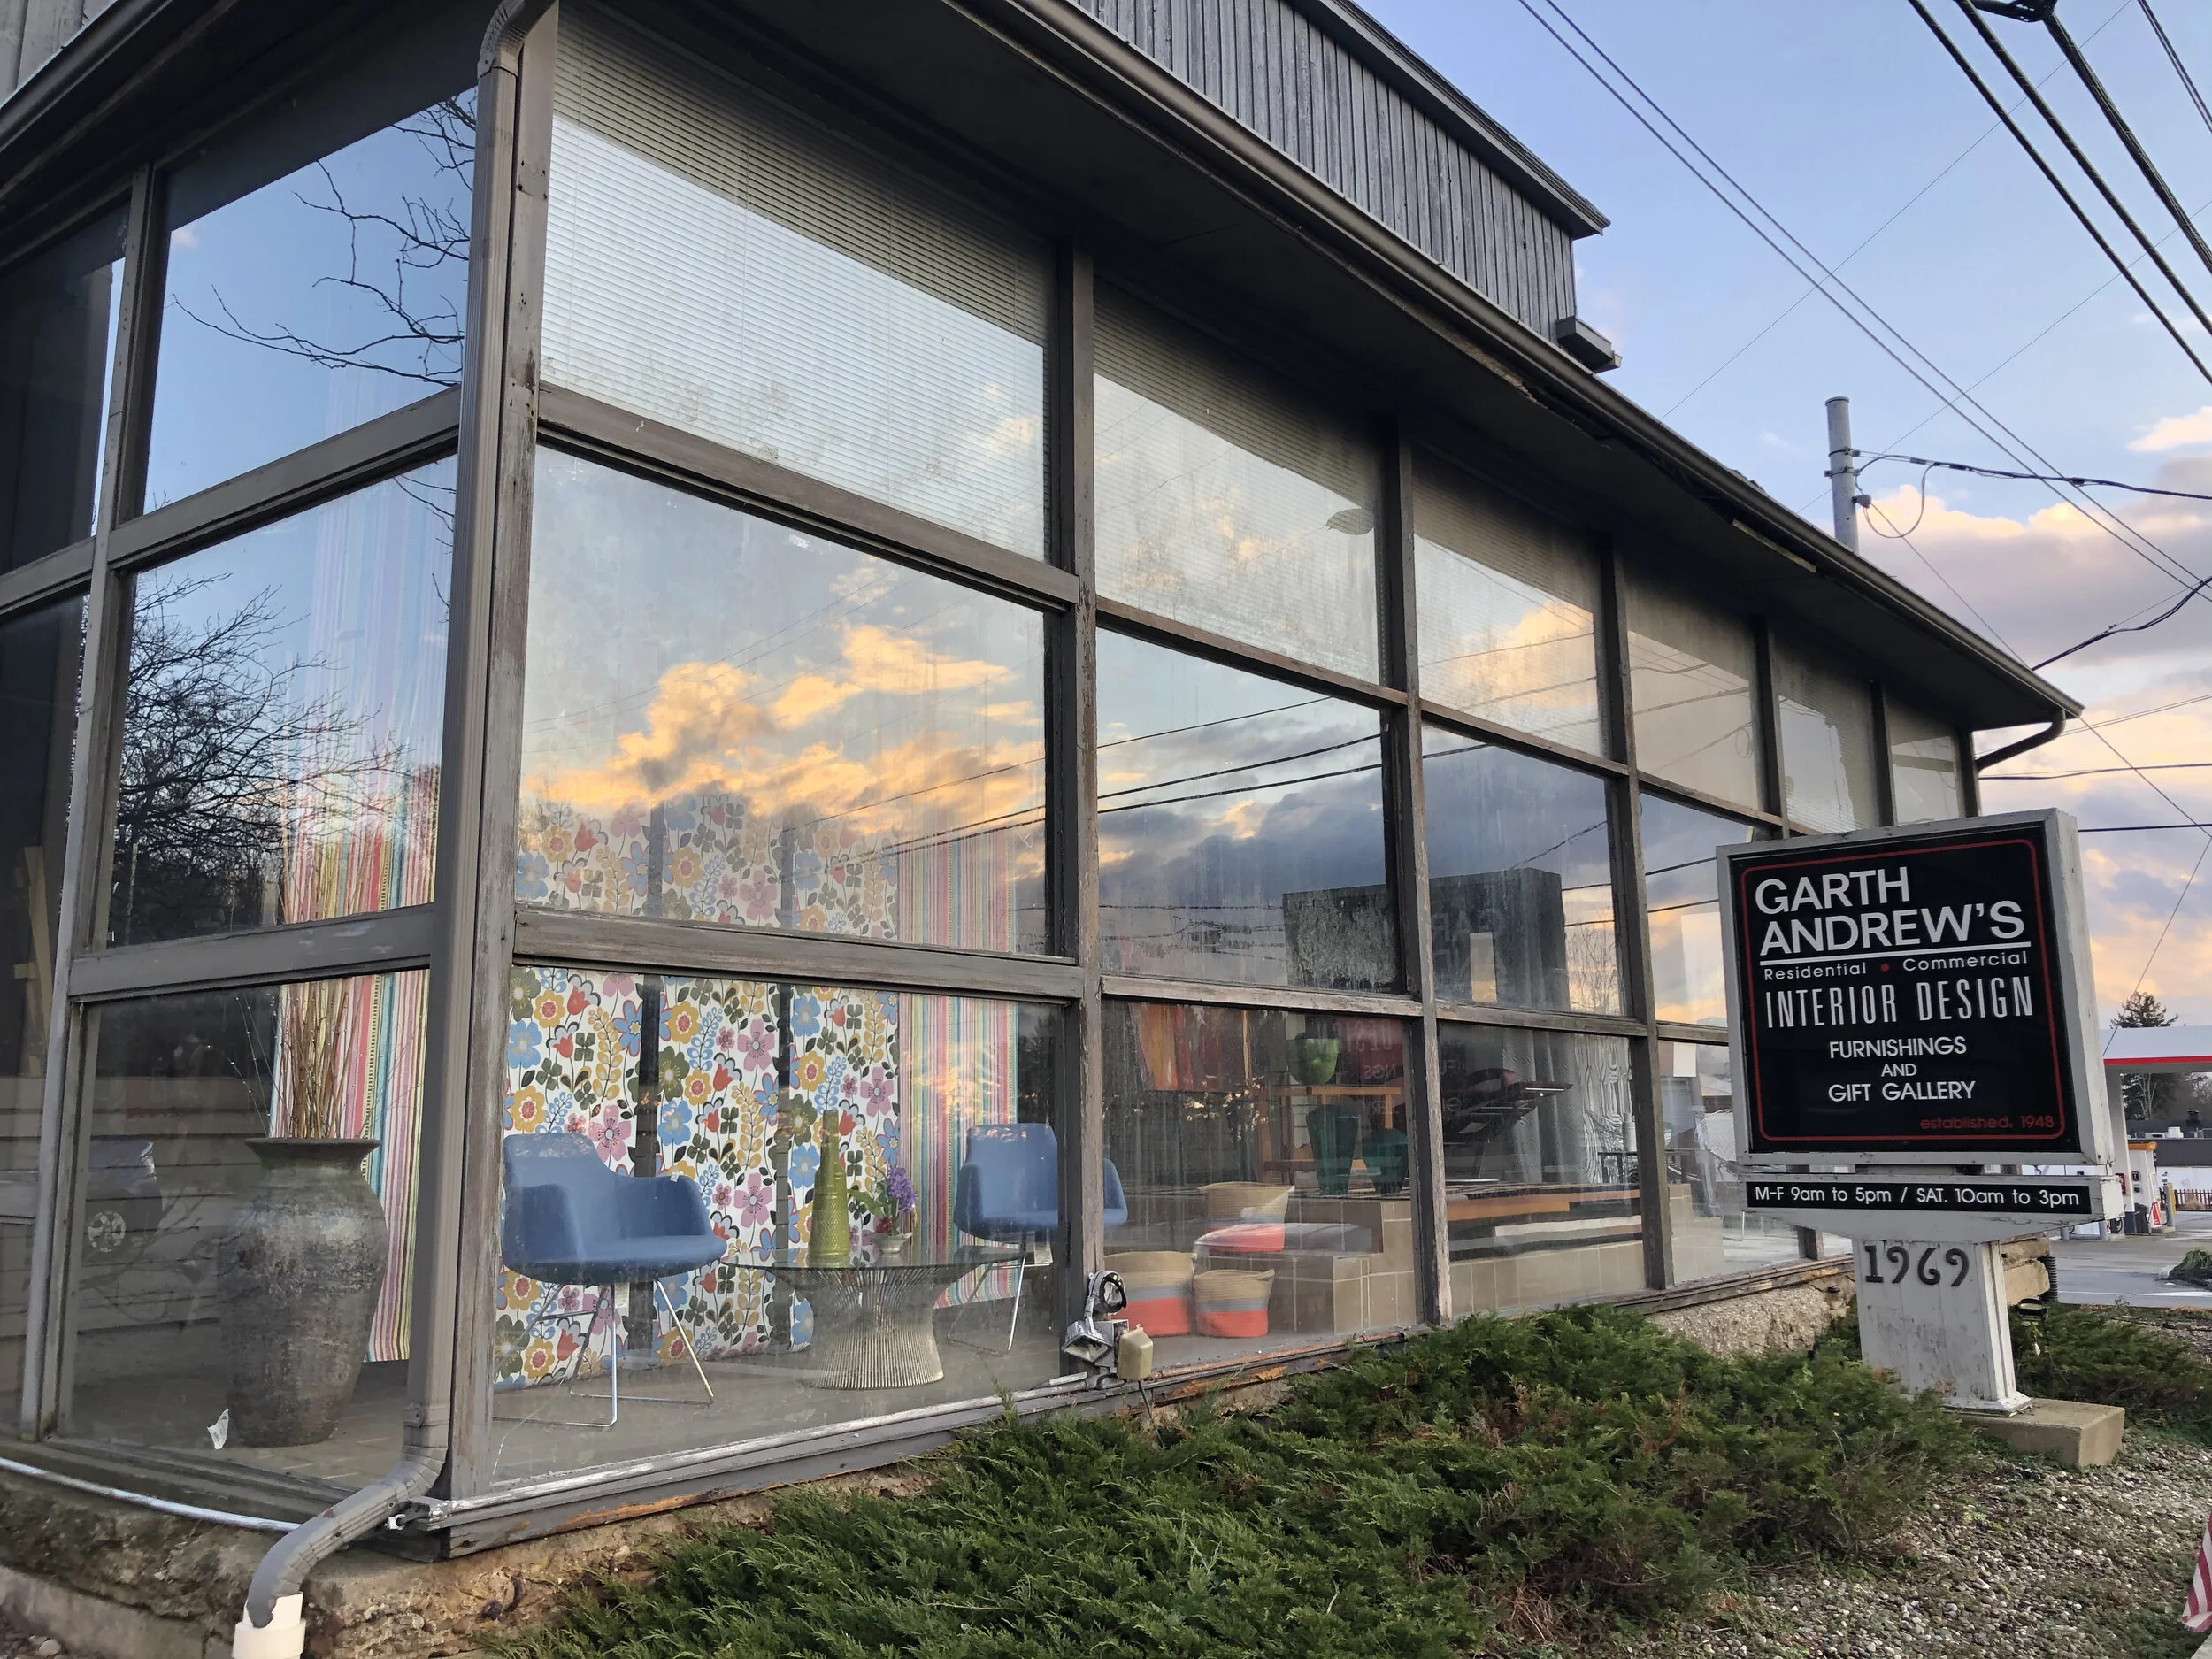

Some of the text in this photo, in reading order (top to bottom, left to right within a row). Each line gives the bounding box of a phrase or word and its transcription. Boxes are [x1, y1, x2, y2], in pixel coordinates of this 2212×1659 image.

[1755, 866, 1910, 915] GARTH
[1759, 900, 2025, 956] ANDREW'S
[1763, 950, 2028, 981] Residential Commercial
[1765, 976, 2033, 1029] INTERIOR DESIGN
[1829, 1035, 1967, 1059] FURNISHINGS
[1880, 1063, 1917, 1078] AND
[1828, 1080, 1976, 1102] GIFT GALLERY
[2019, 1115, 2055, 1129] 1948
[1755, 1186, 1785, 1201] M-F
[1790, 1186, 1825, 1201] 9am
[1832, 1187, 1848, 1202] to
[1855, 1187, 1892, 1205] 5pm
[1916, 1187, 1948, 1203] SAT.
[1955, 1188, 2005, 1204] 10am
[2012, 1189, 2031, 1204] to
[2039, 1189, 2079, 1209] 3pm
[1863, 1244, 1970, 1287] 1969
